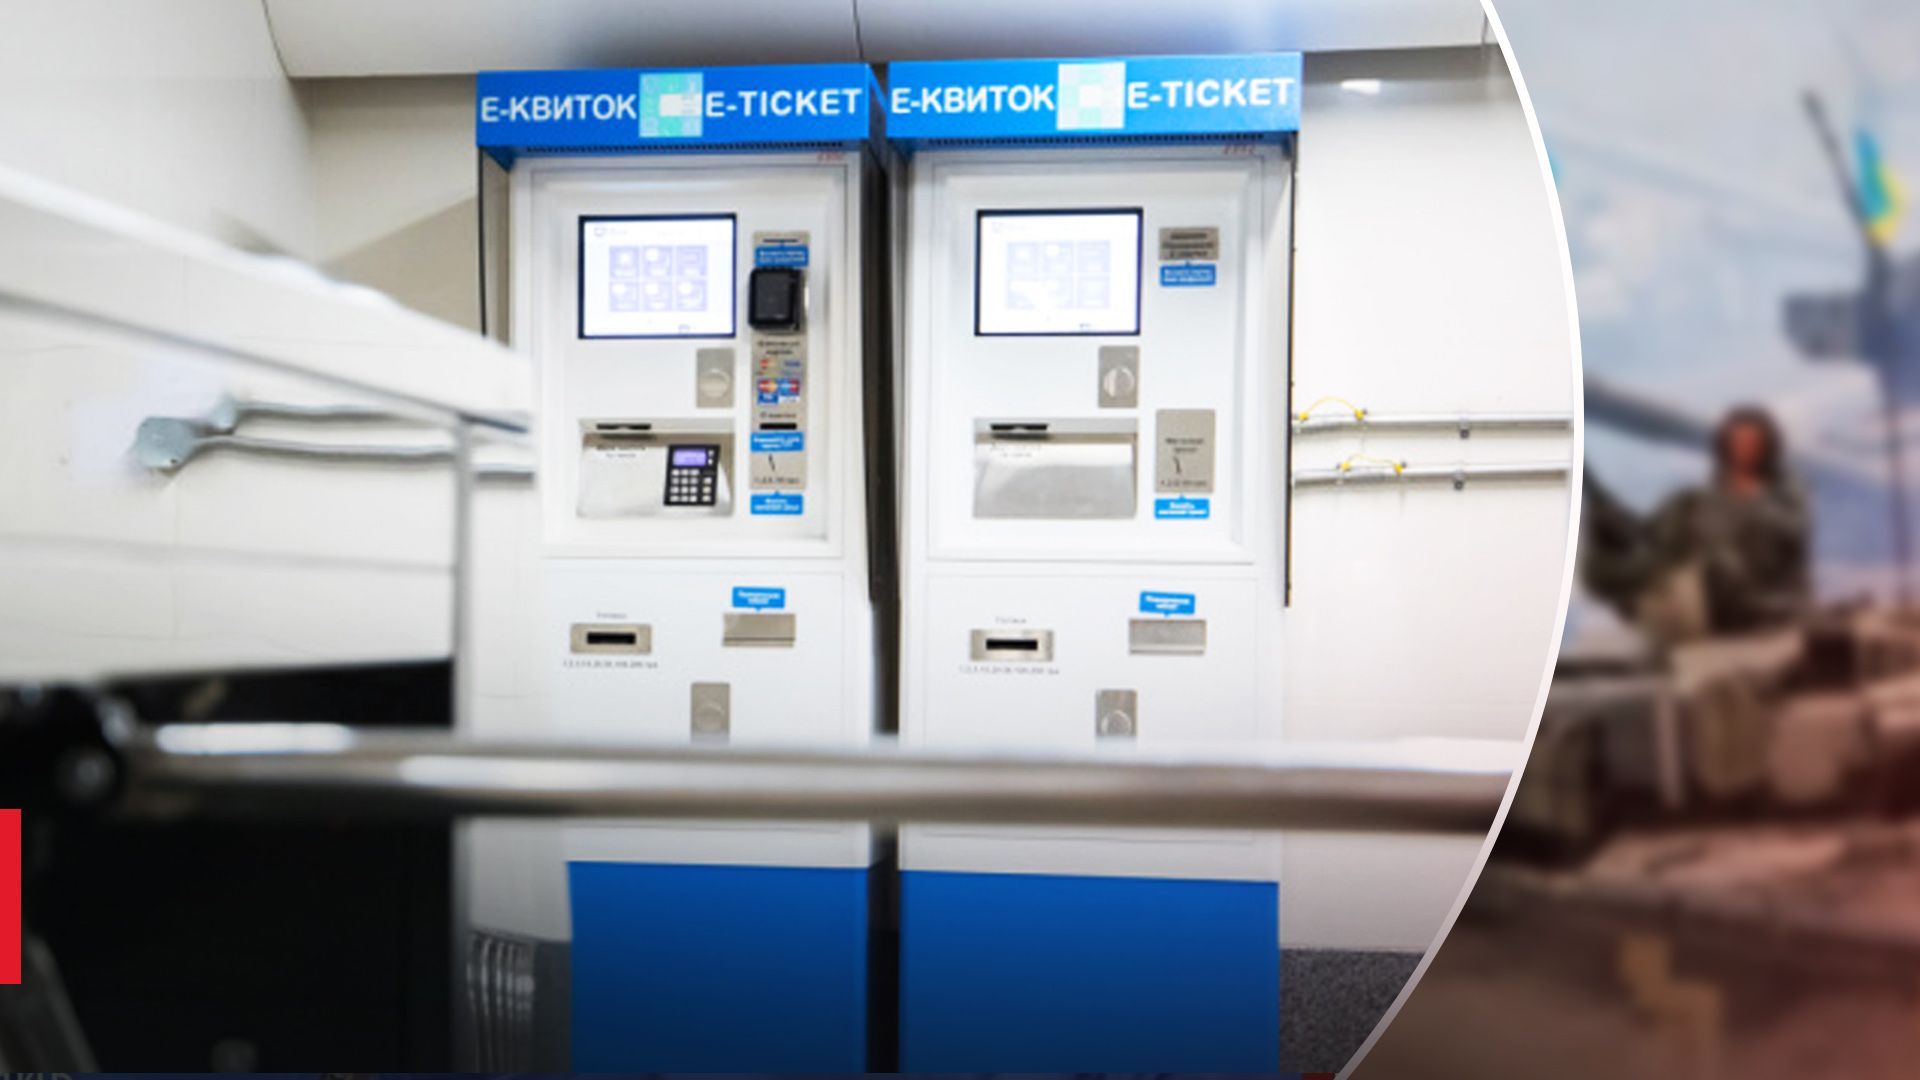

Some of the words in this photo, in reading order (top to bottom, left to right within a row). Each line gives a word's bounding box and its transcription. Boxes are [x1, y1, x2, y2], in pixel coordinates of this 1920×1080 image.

[705, 88, 862, 118] E-TICKET
[891, 85, 1055, 114] Е-КВИТОК
[1127, 77, 1295, 109] E-TICKET
[481, 94, 637, 122] Е-КВИТОК
